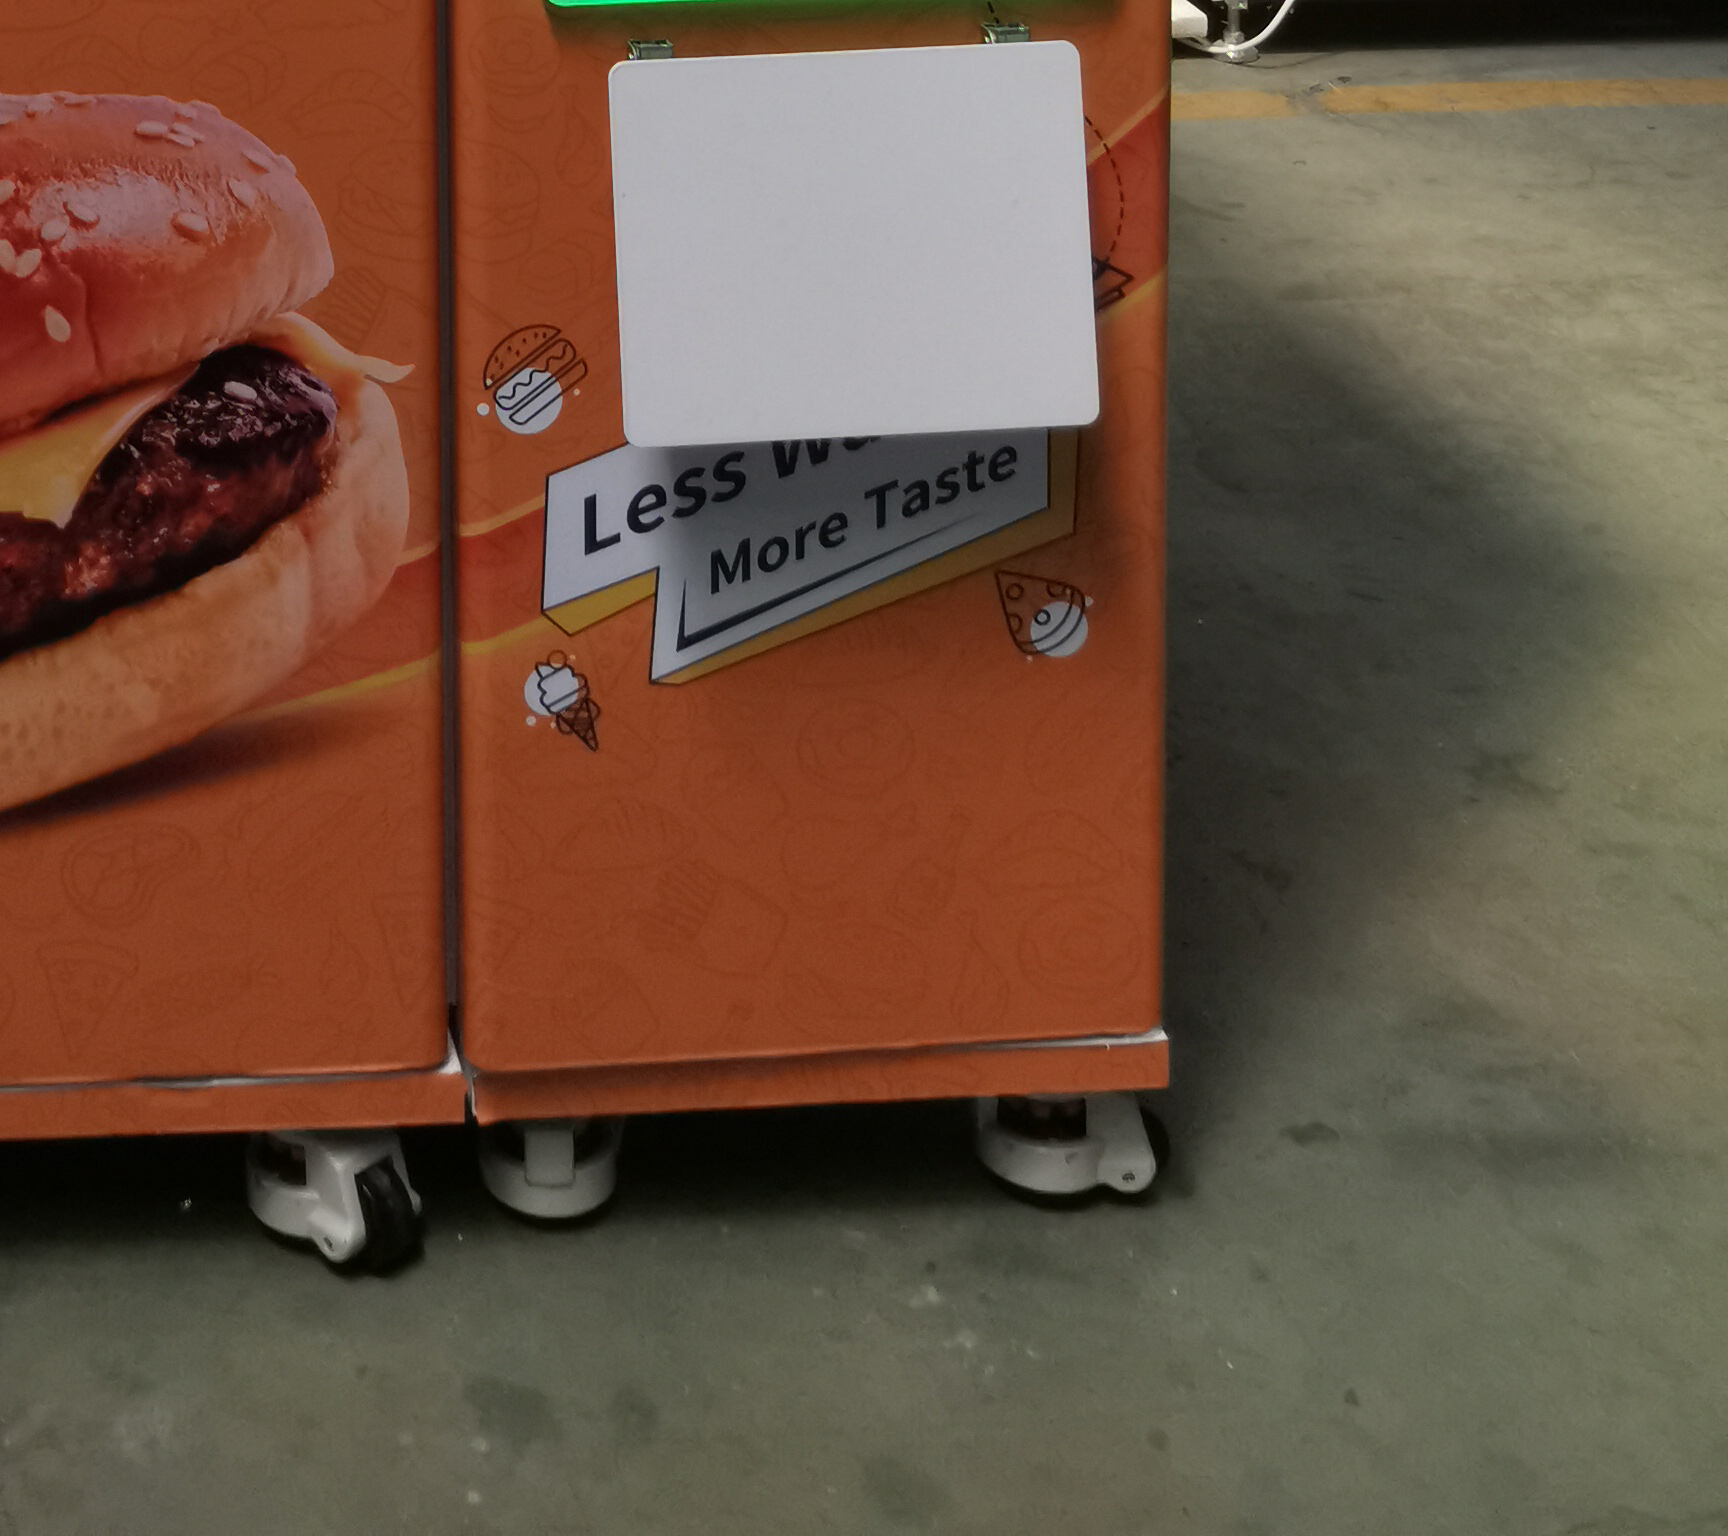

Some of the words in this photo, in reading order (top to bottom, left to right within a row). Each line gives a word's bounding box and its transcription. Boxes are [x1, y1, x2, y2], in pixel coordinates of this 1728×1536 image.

[584, 451, 746, 555] Less
[710, 511, 849, 595] More
[864, 444, 1018, 530] Taste
